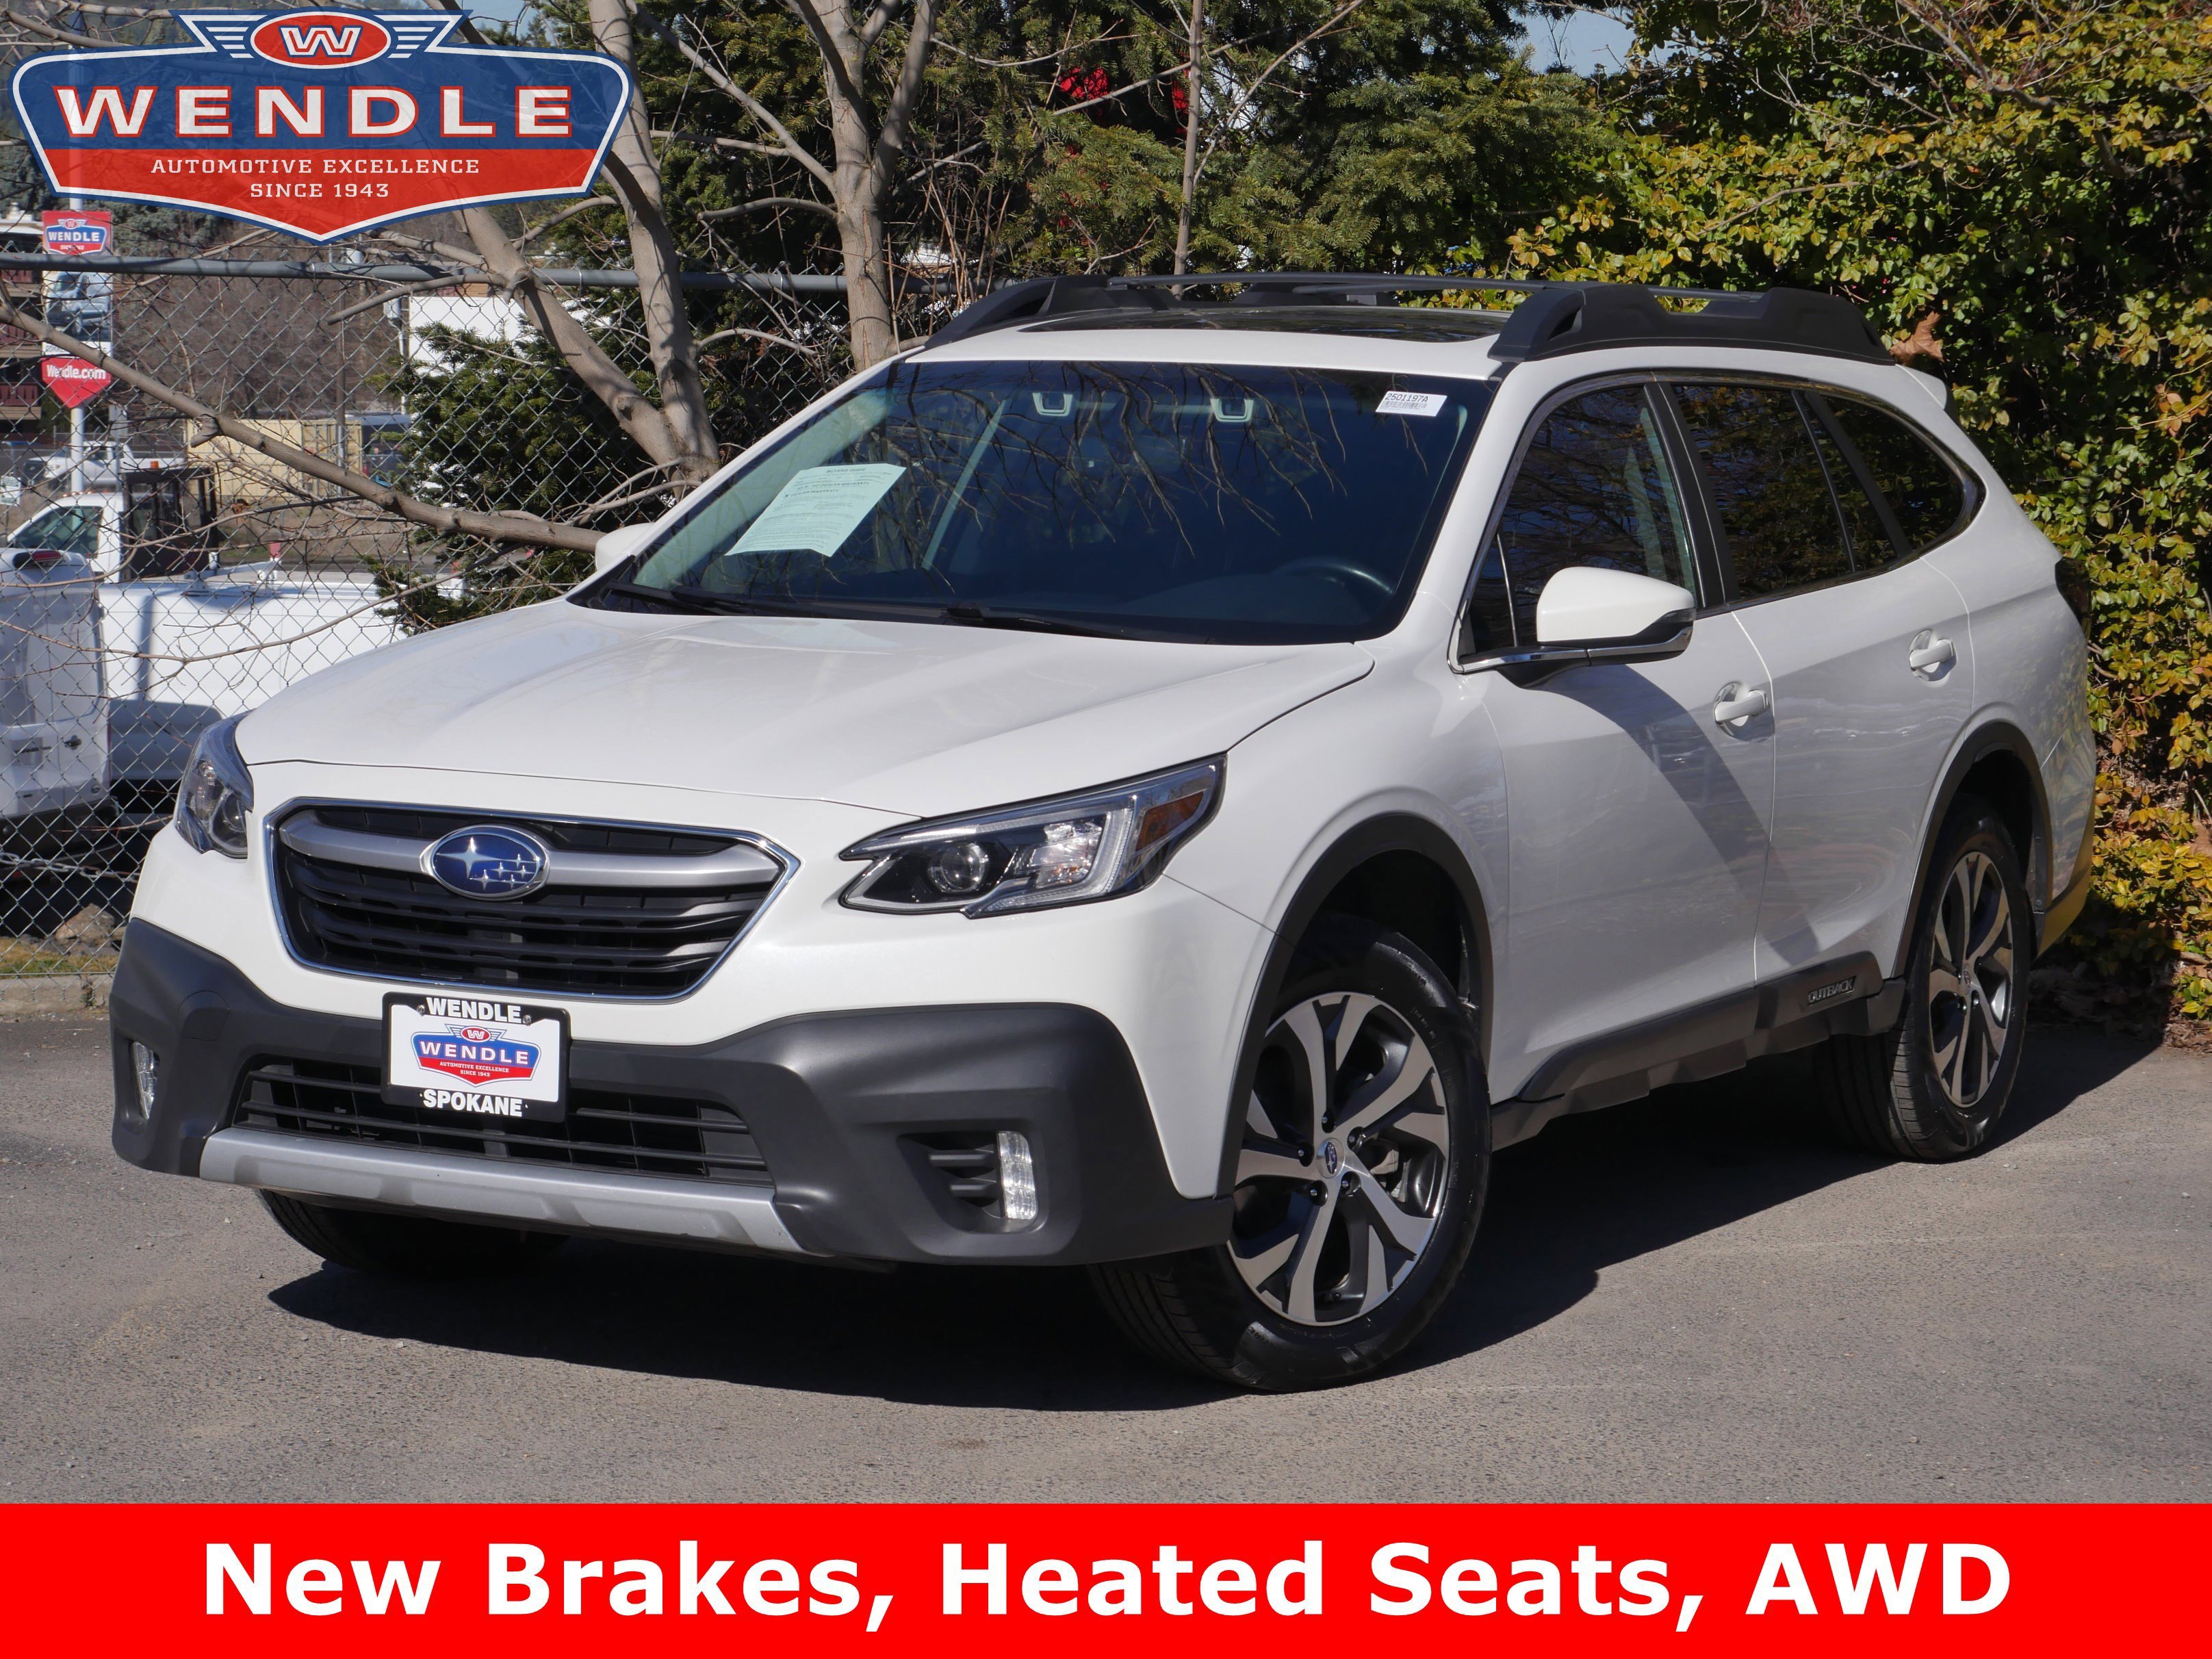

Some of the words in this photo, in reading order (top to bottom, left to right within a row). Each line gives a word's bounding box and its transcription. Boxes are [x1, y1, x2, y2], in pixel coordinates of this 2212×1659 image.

[49, 231, 100, 242] WENDLE
[1385, 393, 1428, 402] 2501197A
[1808, 979, 1853, 1003] OUTBACK
[426, 997, 522, 1024] WENDLE
[420, 1041, 528, 1065] WENDLE
[439, 1062, 474, 1070] AUTOMOTIVE
[475, 1065, 509, 1073] EXCELLENCE
[423, 1089, 522, 1117] SPOKANE
